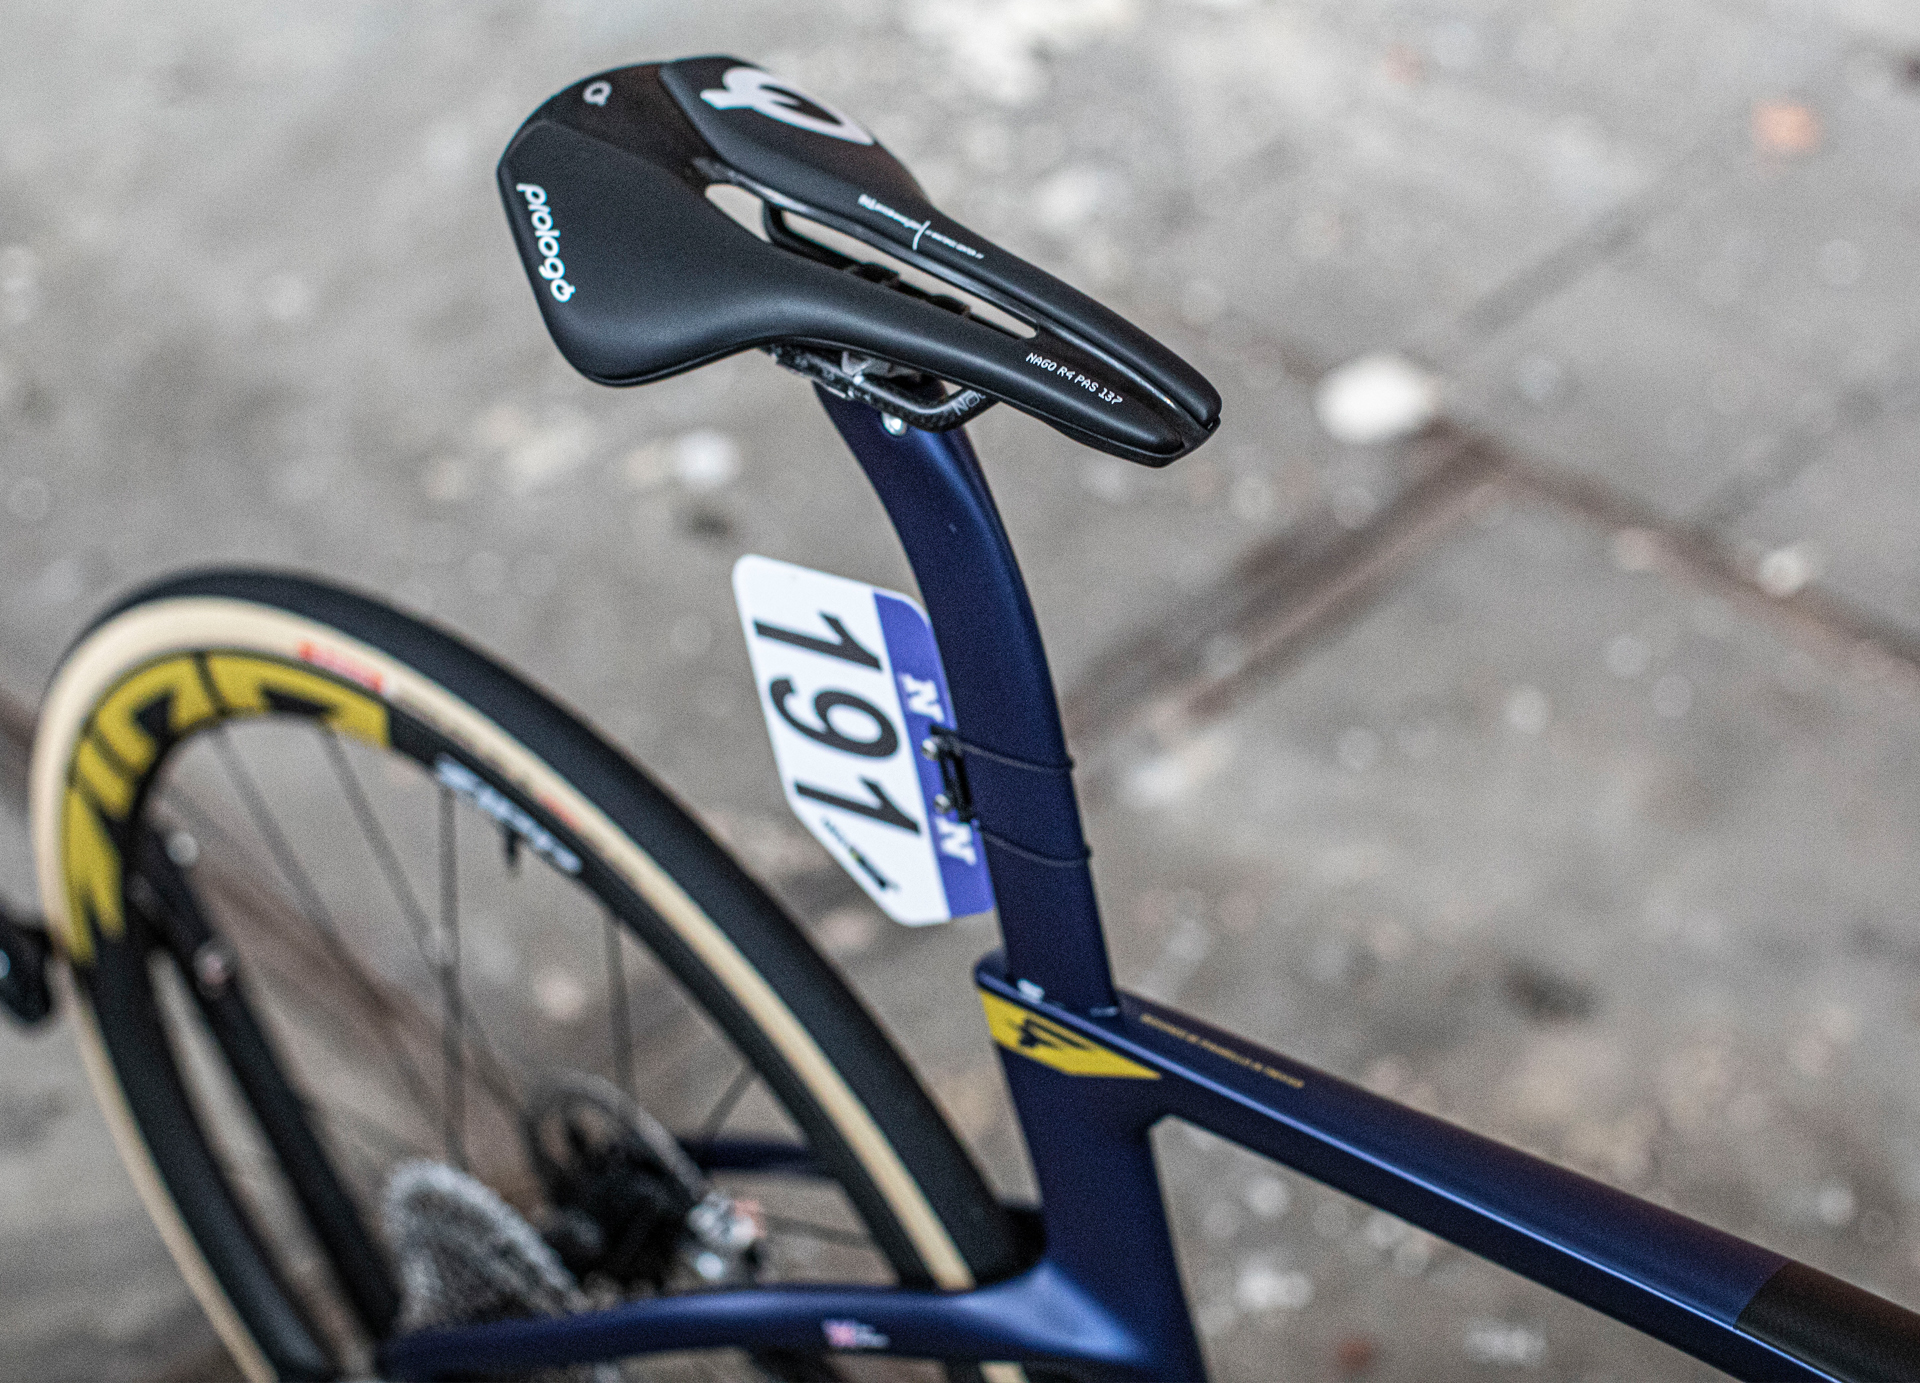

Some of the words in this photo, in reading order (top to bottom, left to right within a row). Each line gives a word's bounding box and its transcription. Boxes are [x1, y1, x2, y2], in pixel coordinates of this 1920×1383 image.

[516, 183, 576, 302] prologo
[1025, 352, 1057, 372] NAGO
[1056, 366, 1076, 380] R4
[1074, 374, 1099, 392] PAS
[1098, 387, 1123, 405] 137
[753, 611, 921, 835] 191
